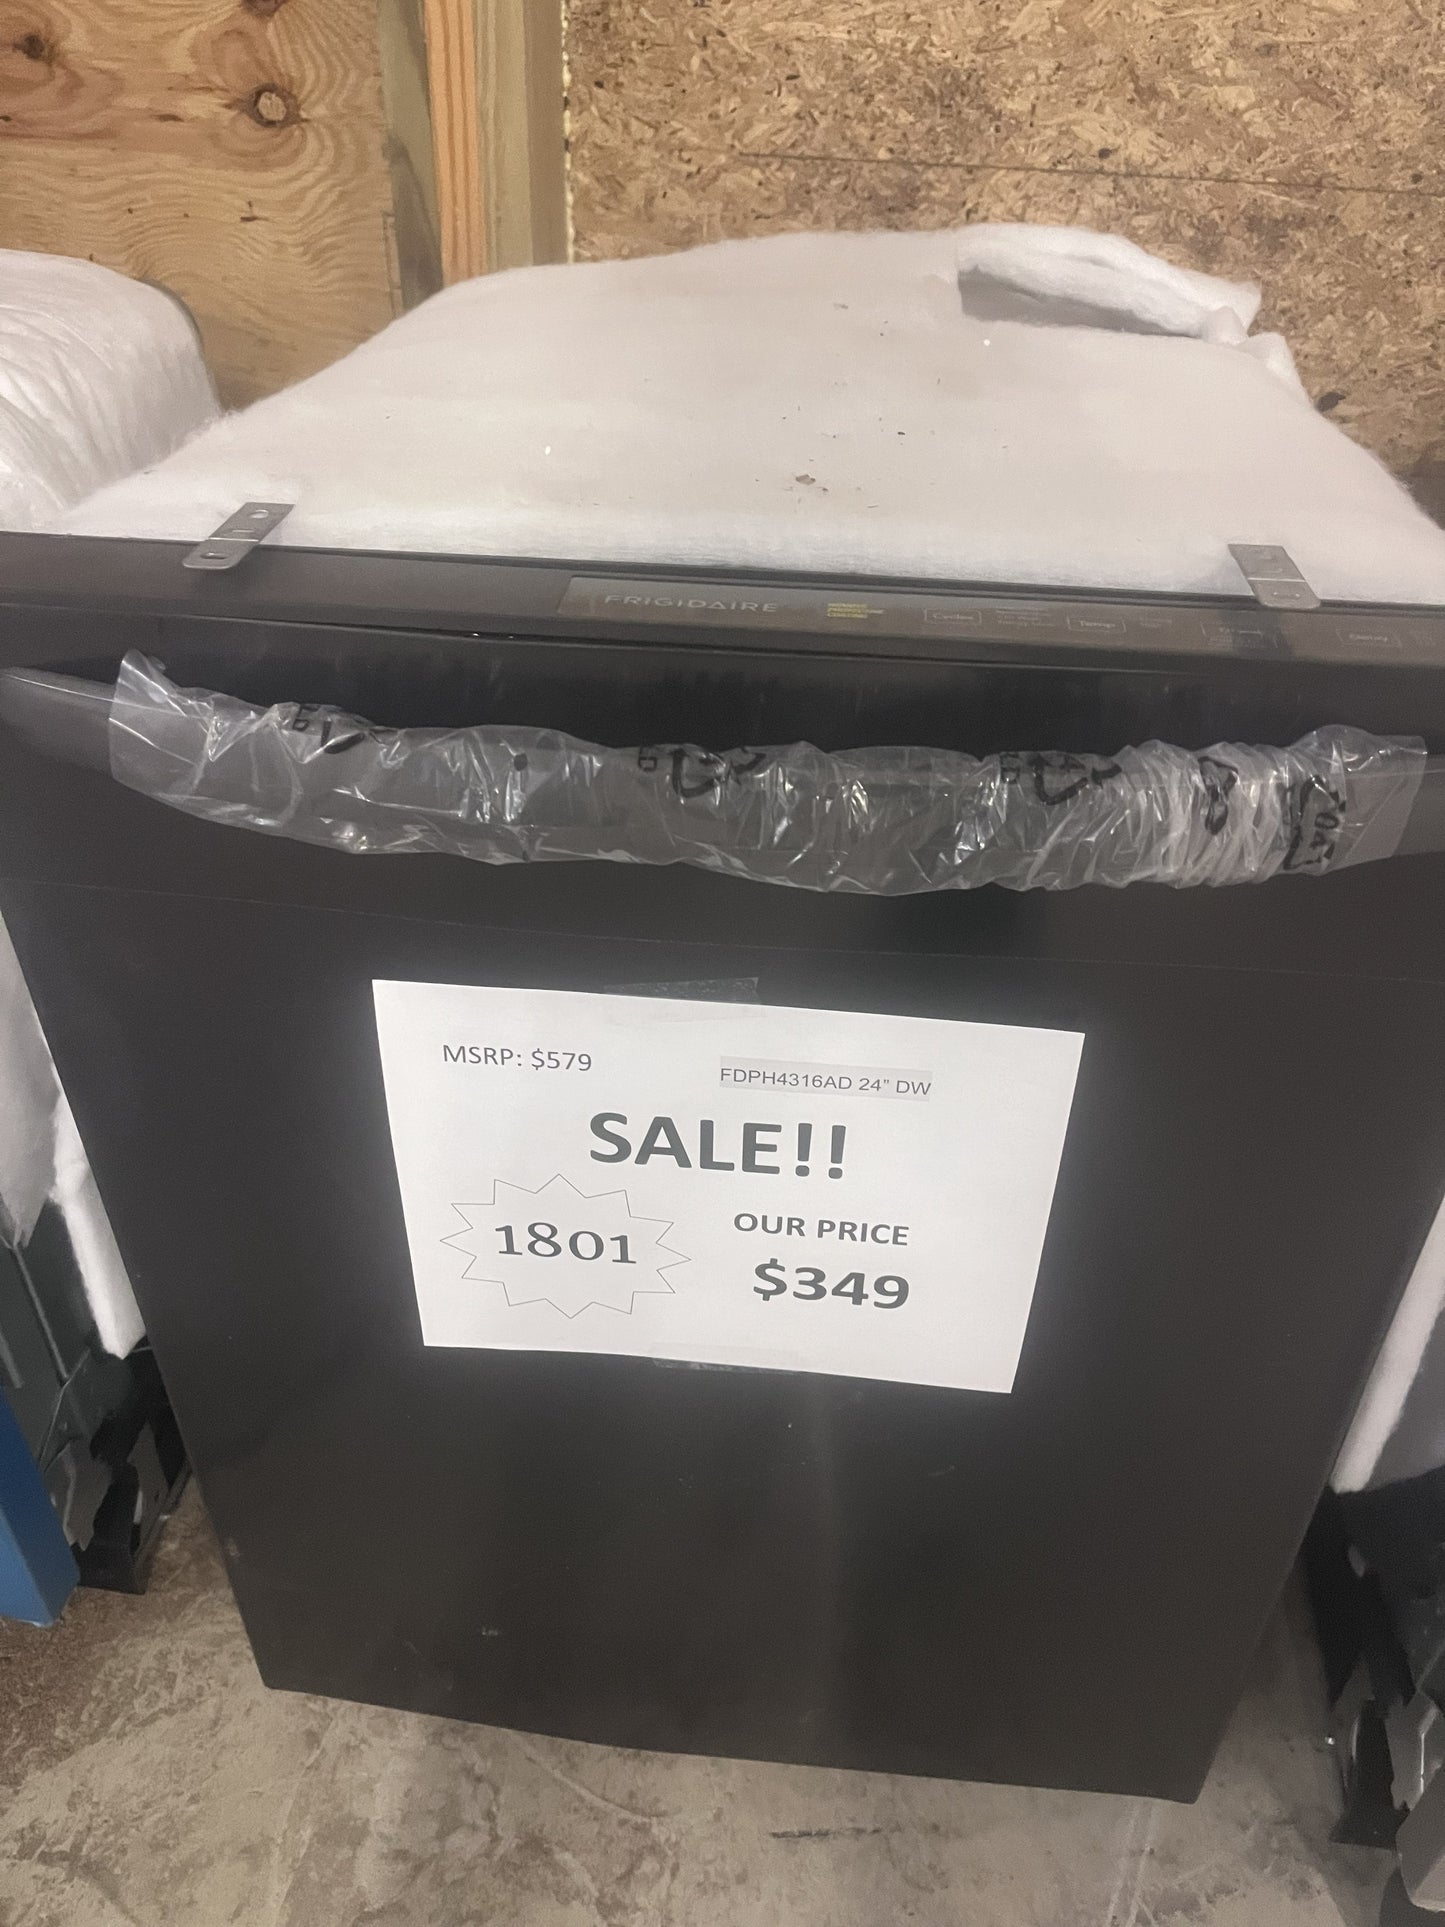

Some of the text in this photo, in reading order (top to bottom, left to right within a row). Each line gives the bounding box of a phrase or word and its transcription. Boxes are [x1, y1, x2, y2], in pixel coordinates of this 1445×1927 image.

[604, 595, 778, 613] FRIGIDAIRE
[443, 1044, 592, 1071] MSRP: $579
[720, 1068, 852, 1090] FDPH4316AD
[896, 1080, 932, 1095] DW
[590, 1112, 847, 1179] SALE!!
[495, 1222, 637, 1264] 1801
[733, 1213, 910, 1246] OUR PRICE
[753, 1258, 910, 1309] $349
